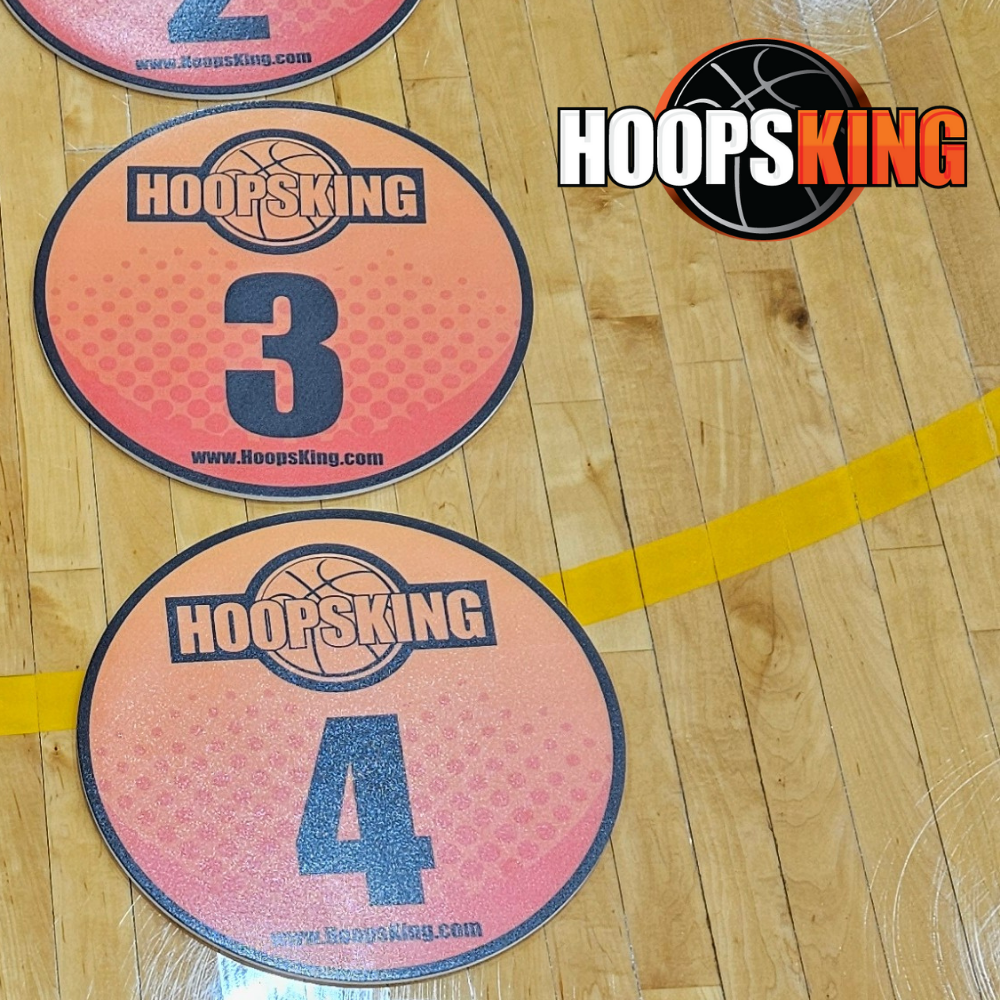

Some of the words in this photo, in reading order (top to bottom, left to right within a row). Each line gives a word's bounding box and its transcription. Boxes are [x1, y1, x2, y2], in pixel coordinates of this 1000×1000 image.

[135, 51, 313, 71] www.HoopsKing.com
[135, 172, 419, 219] HOOPSKING
[223, 272, 345, 439] 3
[190, 449, 385, 467] www.HoopsKing.com
[176, 590, 487, 654] HOOPSKING
[297, 713, 437, 908] 4
